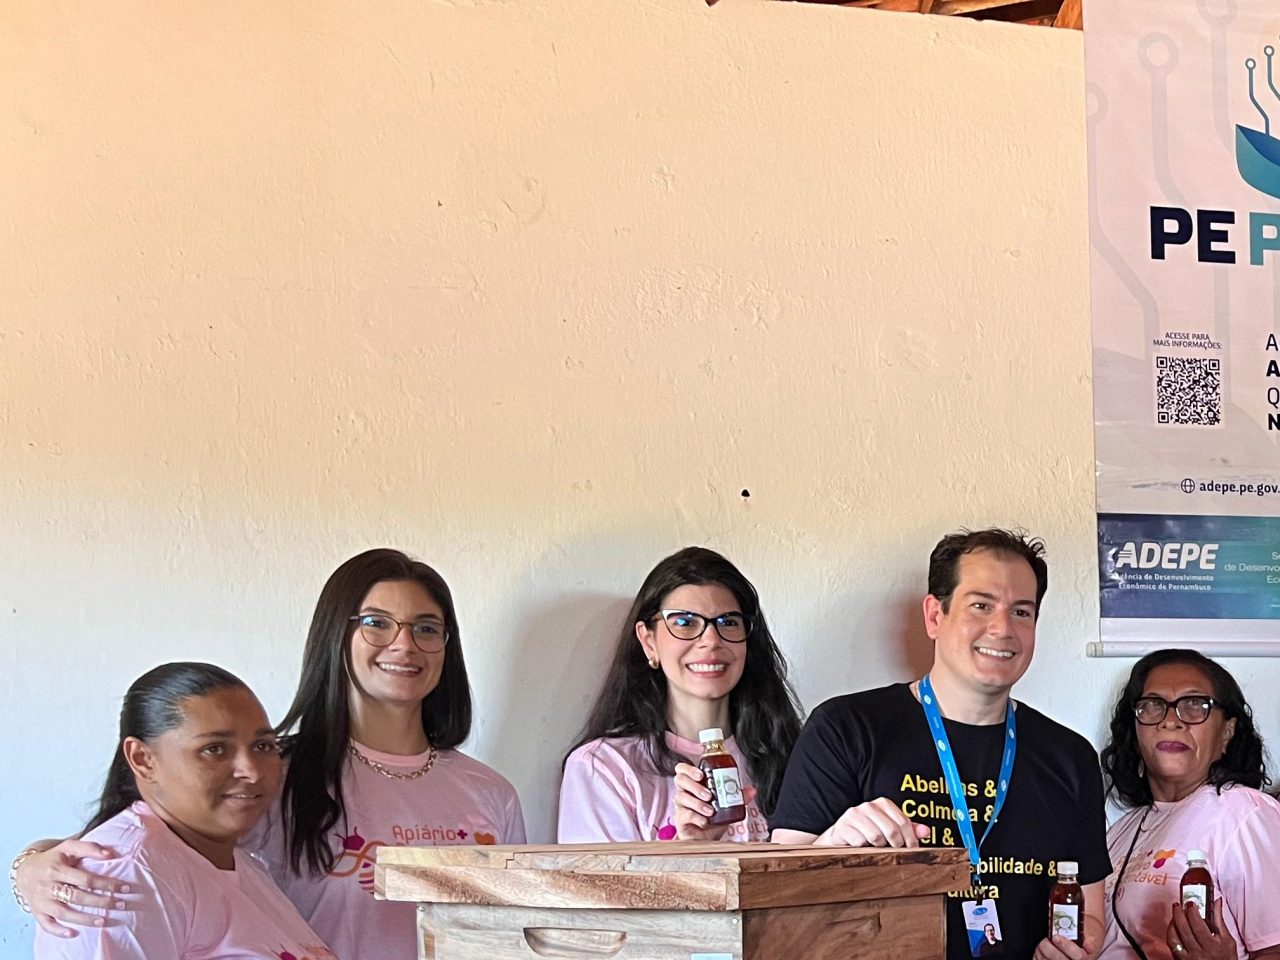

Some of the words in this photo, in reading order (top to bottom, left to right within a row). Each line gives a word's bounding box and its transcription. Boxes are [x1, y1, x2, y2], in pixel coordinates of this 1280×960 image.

[1150, 205, 1236, 264] PE
[1165, 332, 1190, 340] ACESSE
[1115, 541, 1219, 570] ADEPE
[1224, 563, 1237, 572] de
[1144, 573, 1153, 581] de
[1155, 573, 1214, 581] Desenvolvimento
[1169, 583, 1212, 591] Pernambuco
[984, 779, 997, 798] &
[942, 828, 955, 847] &
